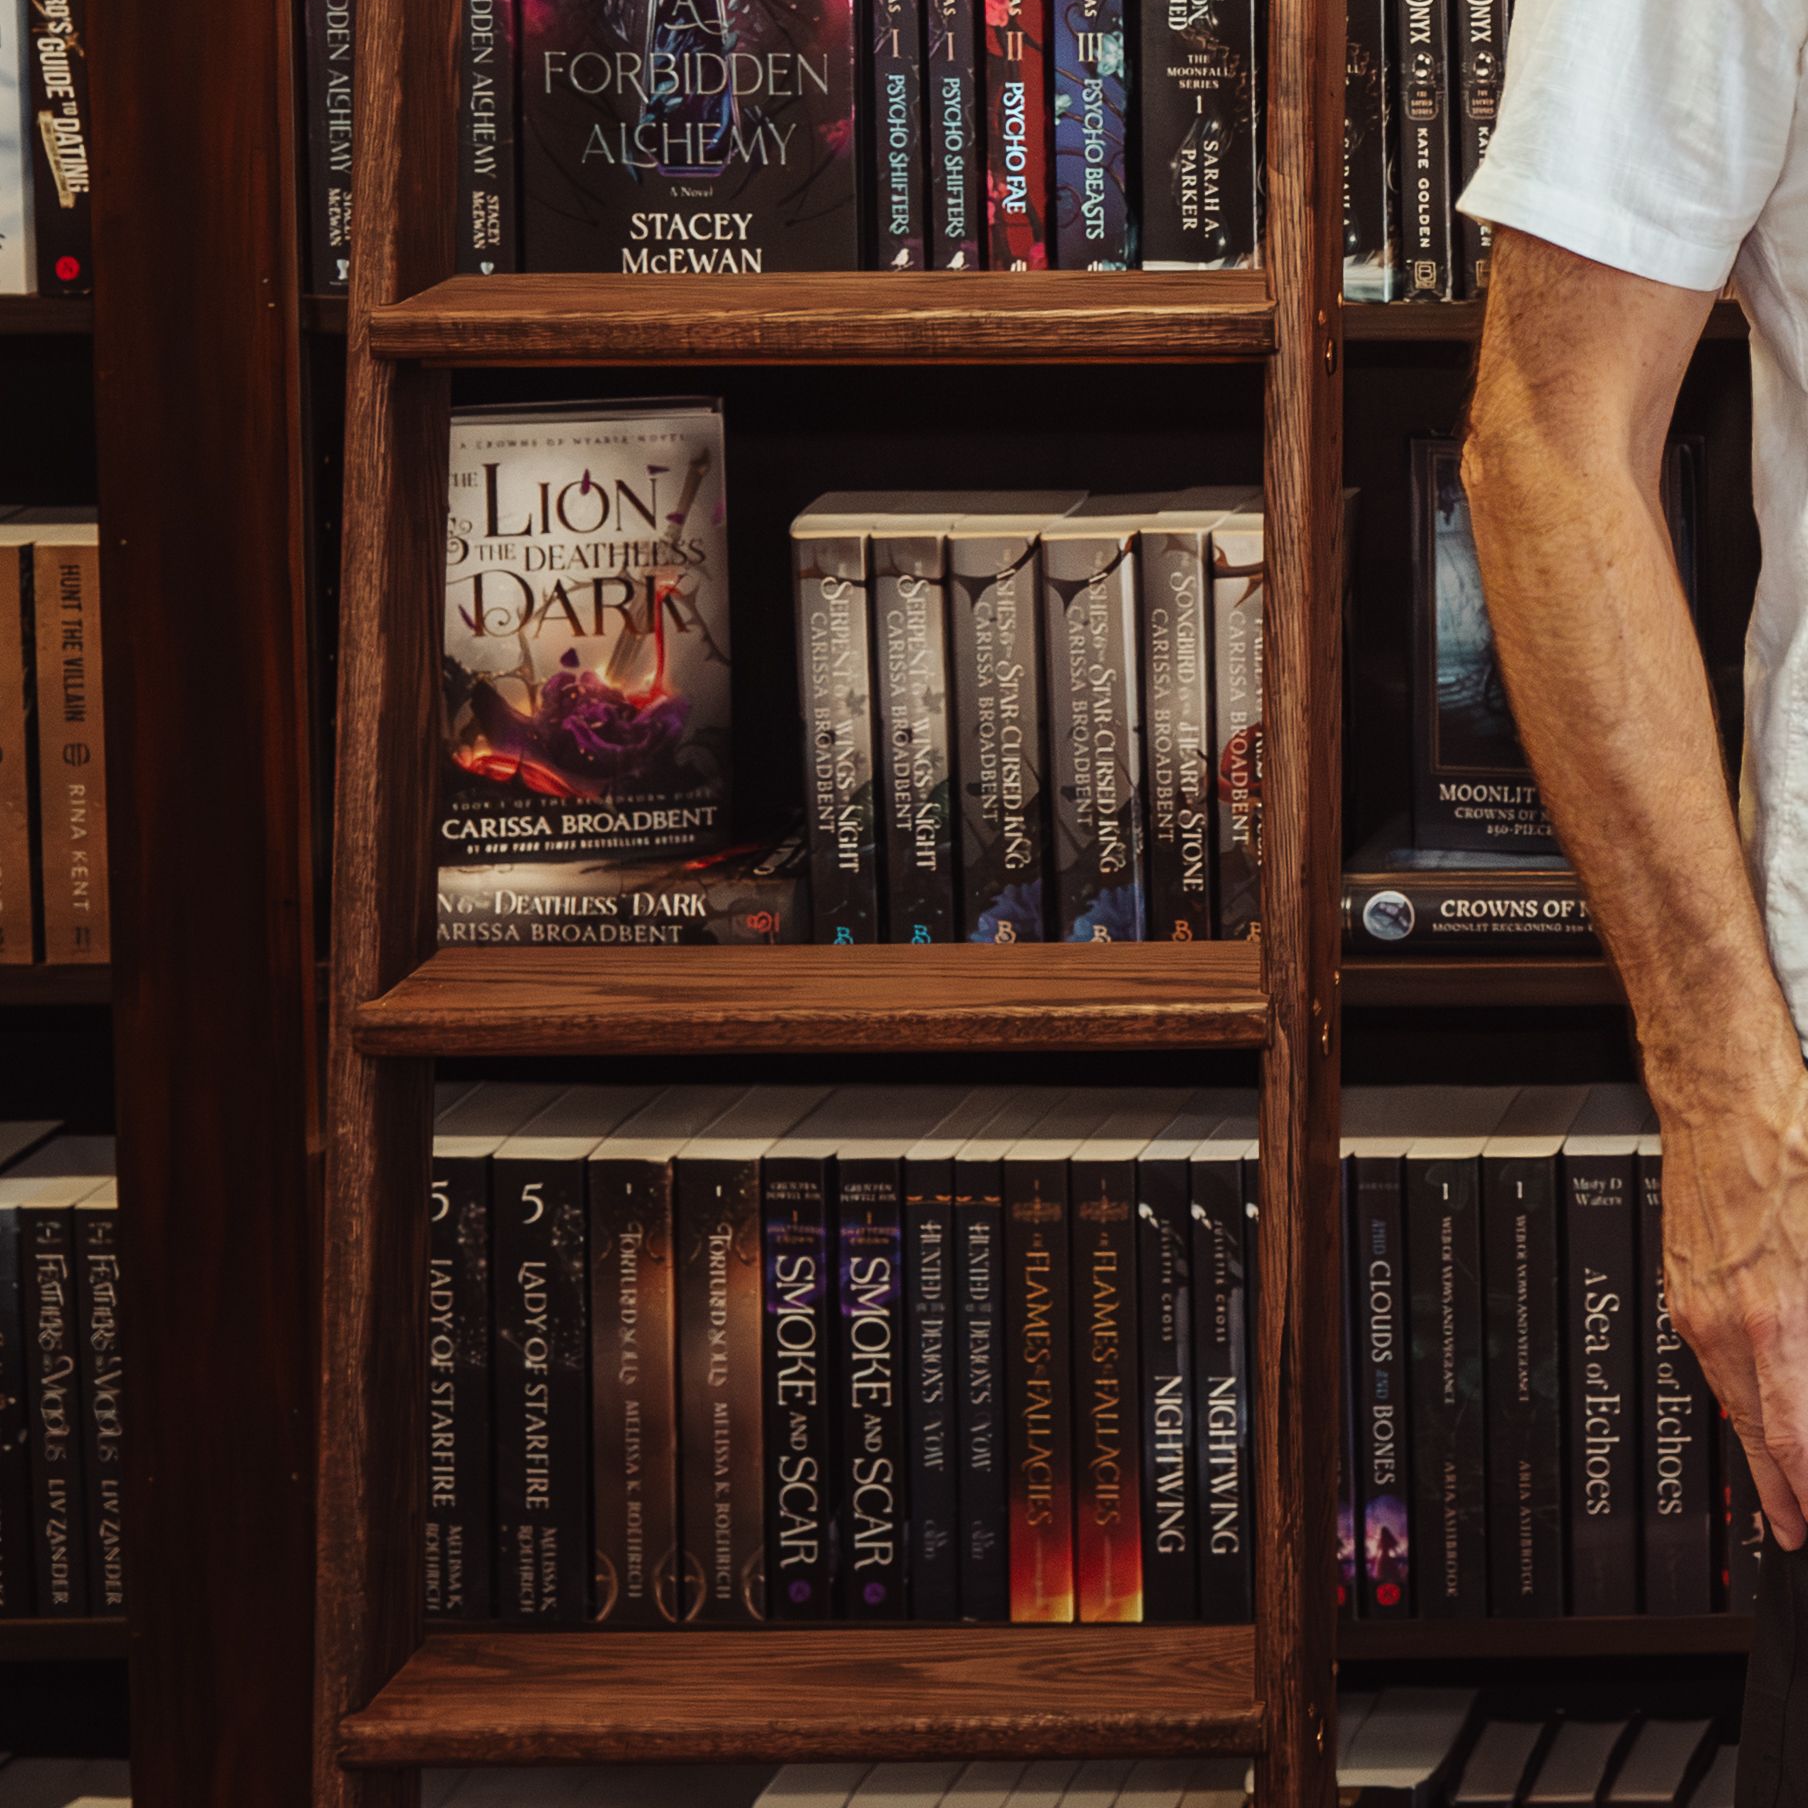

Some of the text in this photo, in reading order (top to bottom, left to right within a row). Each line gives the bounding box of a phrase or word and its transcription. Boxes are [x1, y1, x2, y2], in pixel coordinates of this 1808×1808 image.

[40, 37, 74, 100] GUIDE
[542, 52, 829, 103] FORBIDDEN
[52, 118, 89, 193] DATING
[581, 123, 797, 167] ALCHEMY
[1002, 82, 1027, 215] PSYCHO FAE
[630, 213, 752, 240] STACEY
[1182, 149, 1197, 231] PARKER
[1204, 140, 1219, 238] SARAH A.
[621, 248, 763, 274] McEWAN
[483, 463, 658, 538] LION
[476, 538, 706, 571] THE DEATHLESS
[60, 564, 85, 723] HUNT THE VILLAIN
[459, 570, 694, 639] DARK
[69, 784, 89, 912] RINA KENT
[442, 807, 717, 840] CARISSA BROADBENT
[1370, 1260, 1393, 1363] CLOUDS
[775, 1254, 819, 1571] SMOKE AND SCAR
[1584, 1267, 1620, 1517] A Sea of Echoes
[1154, 1375, 1185, 1555] NIGHTWING
[1373, 1405, 1395, 1486] BONES
